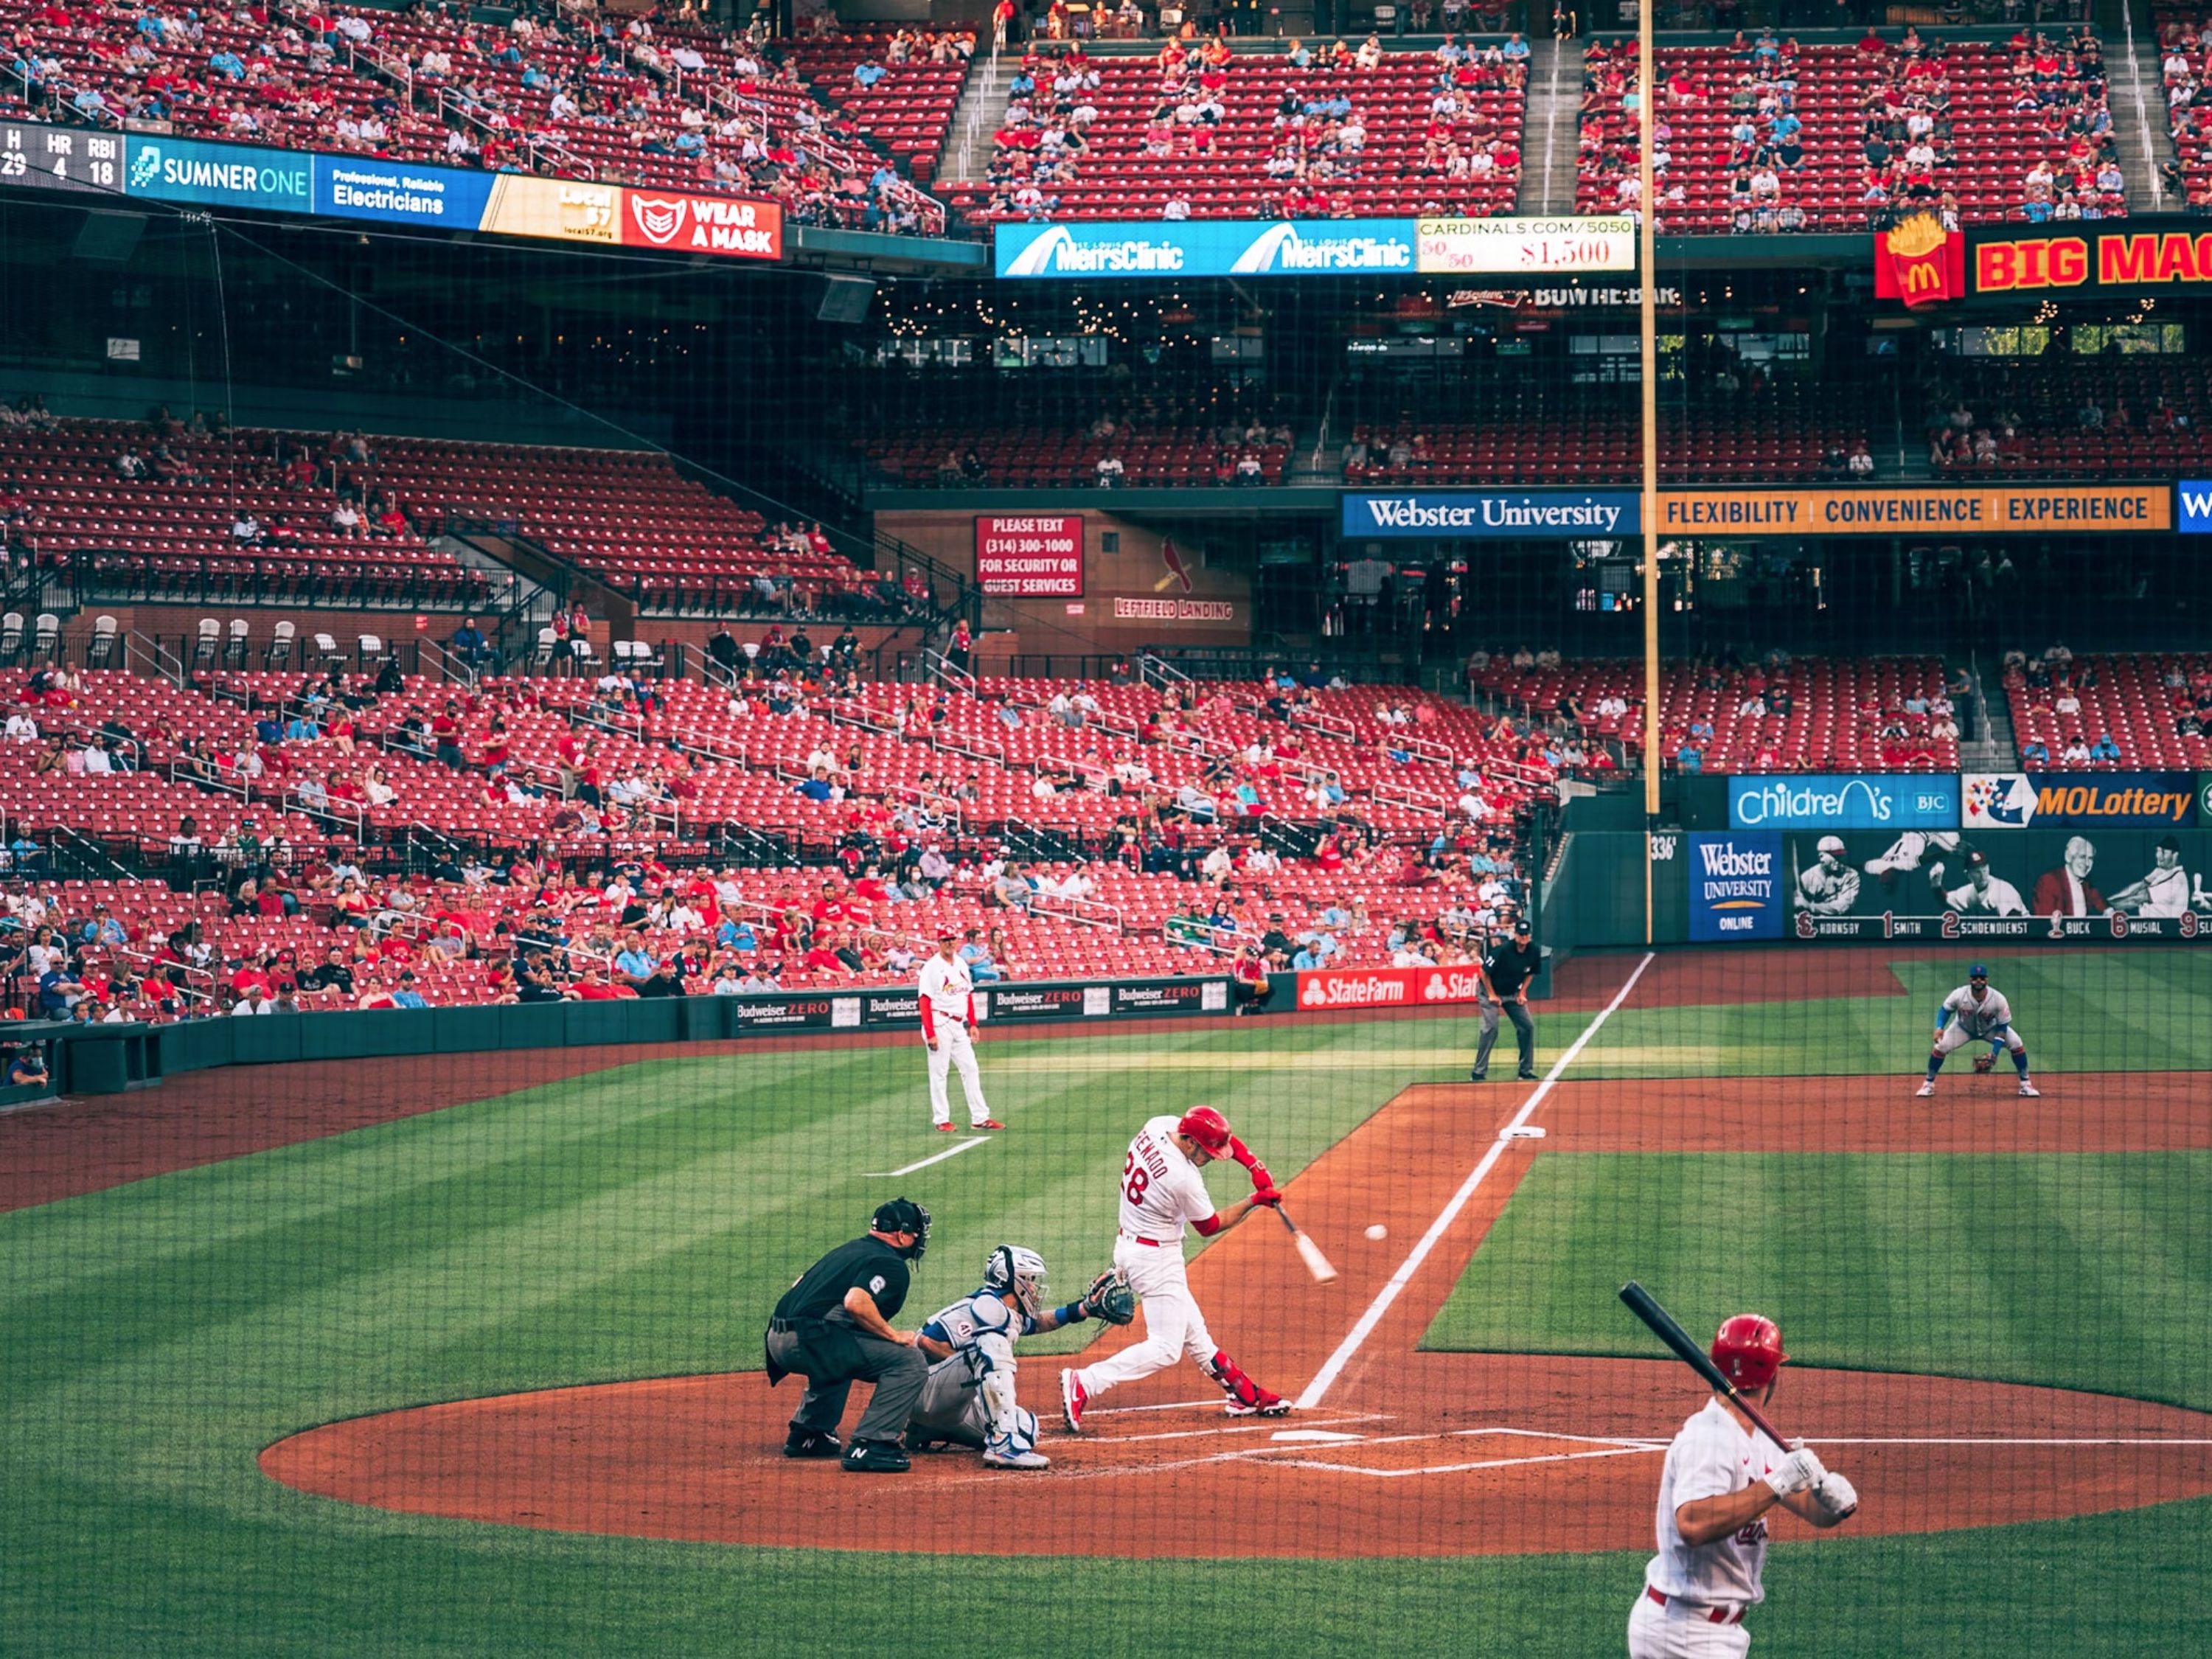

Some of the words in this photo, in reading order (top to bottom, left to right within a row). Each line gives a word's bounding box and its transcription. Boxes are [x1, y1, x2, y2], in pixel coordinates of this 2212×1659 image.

[7, 129, 21, 150] H
[47, 133, 72, 155] HR
[88, 138, 116, 159] RBI
[1, 151, 27, 175] 29
[52, 157, 66, 180] 4
[89, 161, 114, 184] 18
[333, 169, 400, 189] Professional,
[402, 176, 445, 192] Reliable
[333, 184, 444, 215] Electricians
[691, 200, 755, 227] WEAR
[691, 224, 709, 247] A
[712, 226, 773, 253] MASK
[1420, 221, 1632, 235] CARDINALS.COM/5050
[1422, 241, 1447, 256] 50
[1521, 241, 1610, 268] $1,500
[1448, 254, 1473, 268] 50
[1976, 237, 2088, 292] BIG
[1368, 498, 1475, 527] Webster
[1481, 498, 1621, 532] University
[1667, 500, 1798, 524] FLEXIBILITY
[1825, 498, 1982, 522] CONVENIENCE
[2008, 497, 2149, 521] EXPERIENCE
[992, 518, 1035, 532] PLEASE
[1037, 518, 1064, 532] TEXT
[986, 539, 1017, 554] (314)
[1019, 539, 1074, 552] 300-1000
[980, 559, 1003, 572] FOR
[1004, 558, 1059, 572] SECURITY
[1060, 558, 1077, 572] OR
[984, 578, 1020, 592] GUEST
[1022, 578, 1076, 592] SERVICES
[1114, 597, 1178, 619] LEFTFIELD
[1178, 599, 1233, 620] LANDING
[1918, 796, 1945, 811] BJC
[2036, 787, 2192, 821] MOLottery
[1700, 842, 1772, 876] Webster
[1704, 880, 1772, 900] UNIVERSITY
[1719, 917, 1754, 931] ONLINE
[1819, 922, 1860, 934] HORNSBY
[1884, 911, 1893, 938] 1
[1894, 922, 1921, 934] SMITH
[1941, 911, 1960, 938] 2
[1961, 922, 2028, 934] SCHOENDIENST
[2066, 922, 2090, 933] BUCK
[2111, 911, 2129, 937] 6
[2130, 922, 2163, 934] MUSIAL
[2180, 911, 2198, 937] 9
[997, 992, 1043, 1005] Budweiser
[1044, 991, 1082, 1003] ZERO
[1118, 988, 1163, 1001] Budweiser
[1164, 987, 1200, 998] ZERO
[737, 1004, 786, 1018] Budweiser
[787, 1002, 830, 1015] ZERO
[870, 998, 918, 1012] Budweiser
